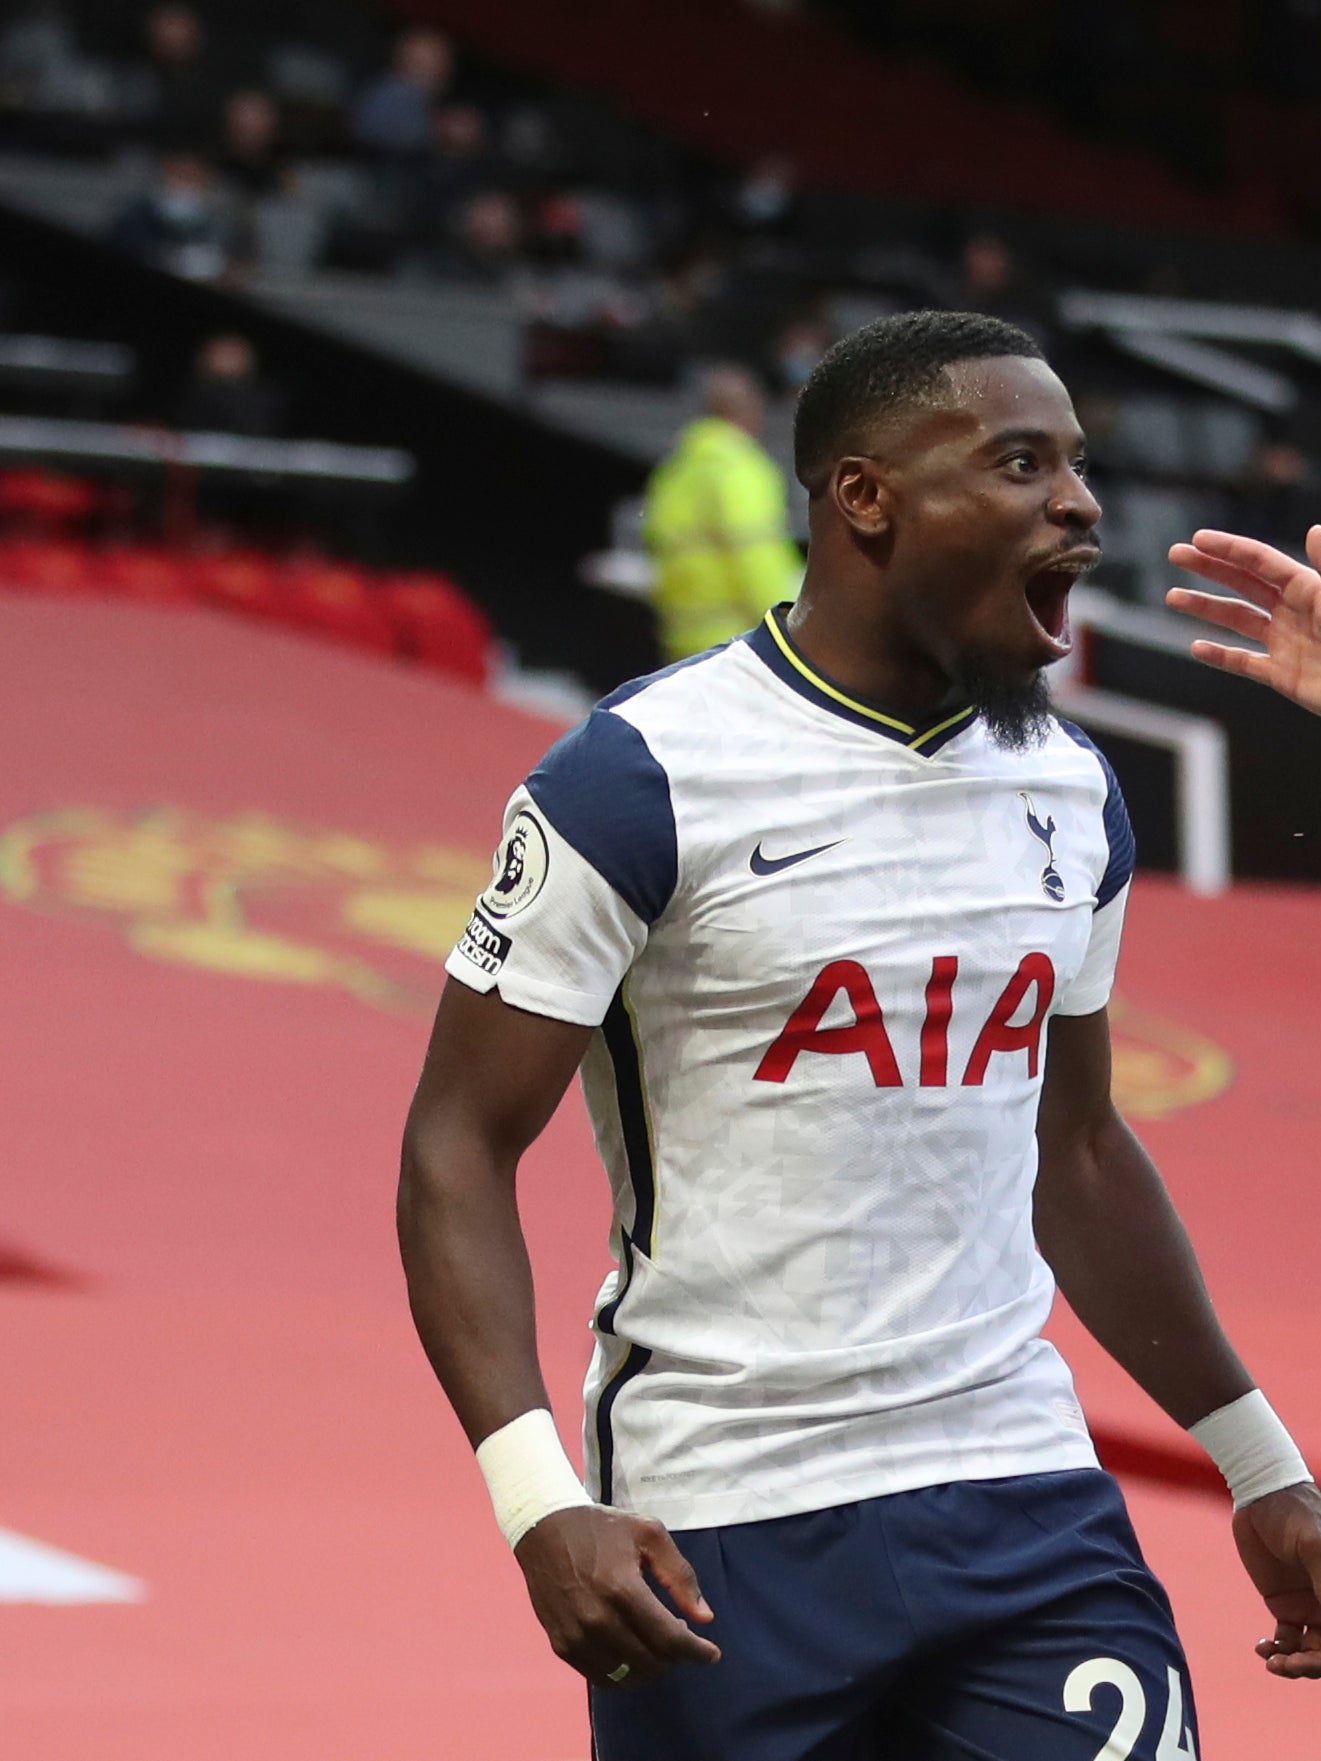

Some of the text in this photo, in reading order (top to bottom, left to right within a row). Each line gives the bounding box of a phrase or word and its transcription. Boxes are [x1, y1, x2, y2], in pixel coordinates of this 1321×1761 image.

[490, 877, 534, 909] Premier League
[457, 933, 502, 975] acism
[468, 916, 501, 955] room
[751, 951, 1055, 1088] AIA
[1063, 1657, 1198, 1761] 24
